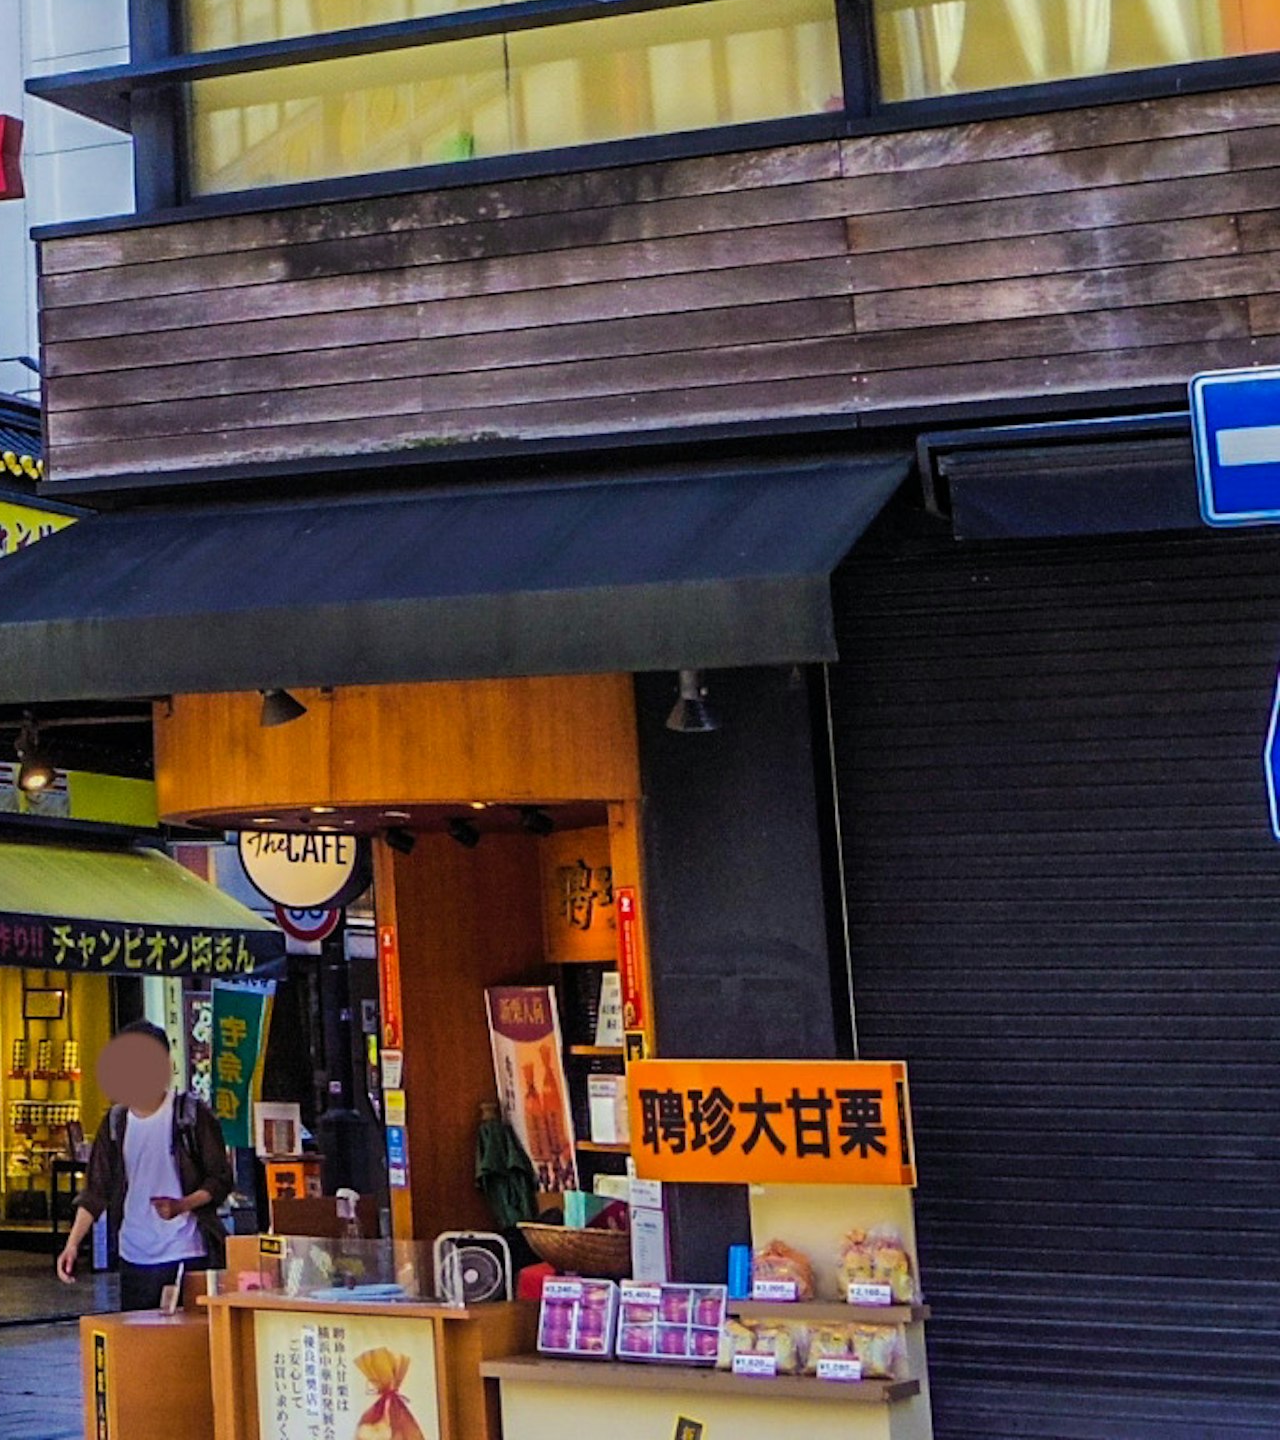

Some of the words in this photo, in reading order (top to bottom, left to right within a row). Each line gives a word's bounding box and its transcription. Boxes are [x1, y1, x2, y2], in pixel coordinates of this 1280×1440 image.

[247, 832, 289, 857] The
[287, 832, 347, 866] CAFE
[52, 924, 256, 973] チャンピオン肉まん
[638, 1086, 888, 1160] 聘珍大甘栗
